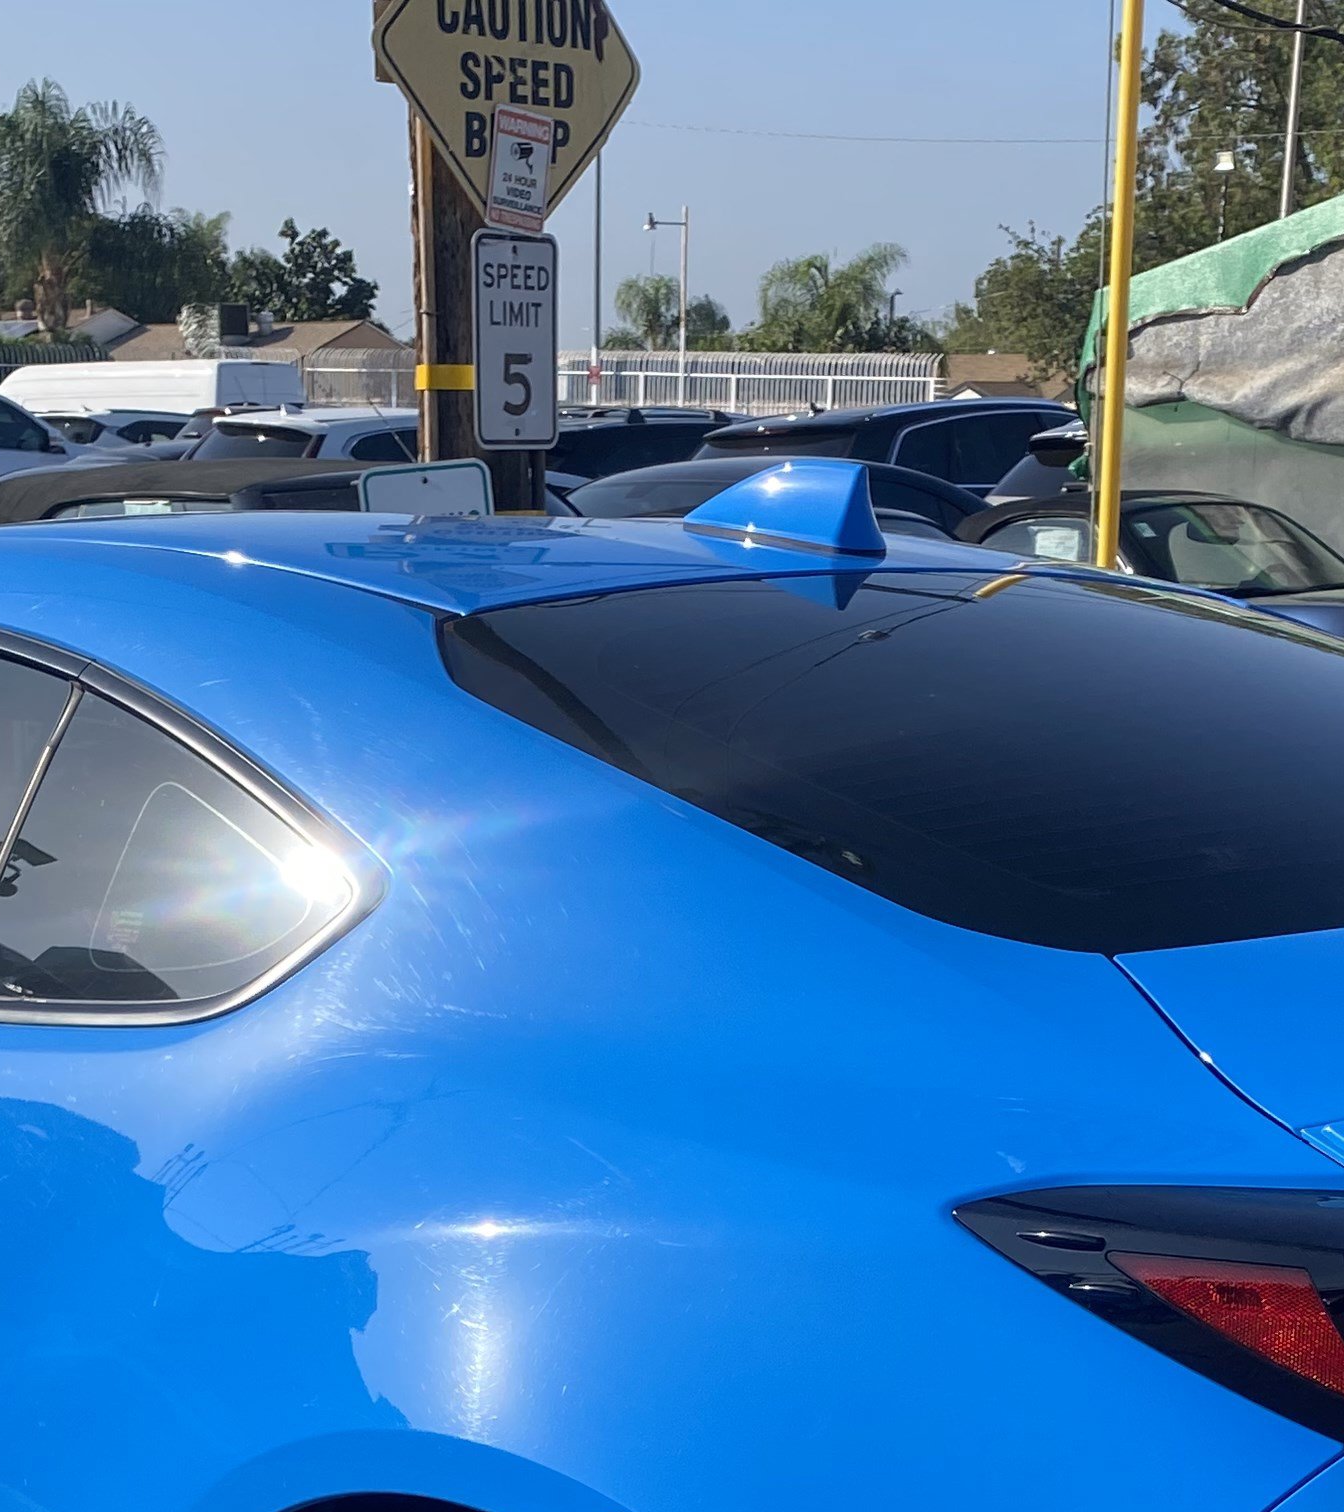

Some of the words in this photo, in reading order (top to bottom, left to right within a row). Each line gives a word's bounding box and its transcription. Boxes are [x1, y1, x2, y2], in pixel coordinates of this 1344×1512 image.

[460, 52, 574, 109] SPEED
[465, 111, 570, 164] BP
[499, 113, 551, 139] WARNING
[506, 186, 532, 201] VIDEO
[514, 175, 537, 189] HOUR
[482, 262, 550, 291] SPEED
[489, 300, 542, 328] LIMIT
[503, 353, 532, 416] 5
